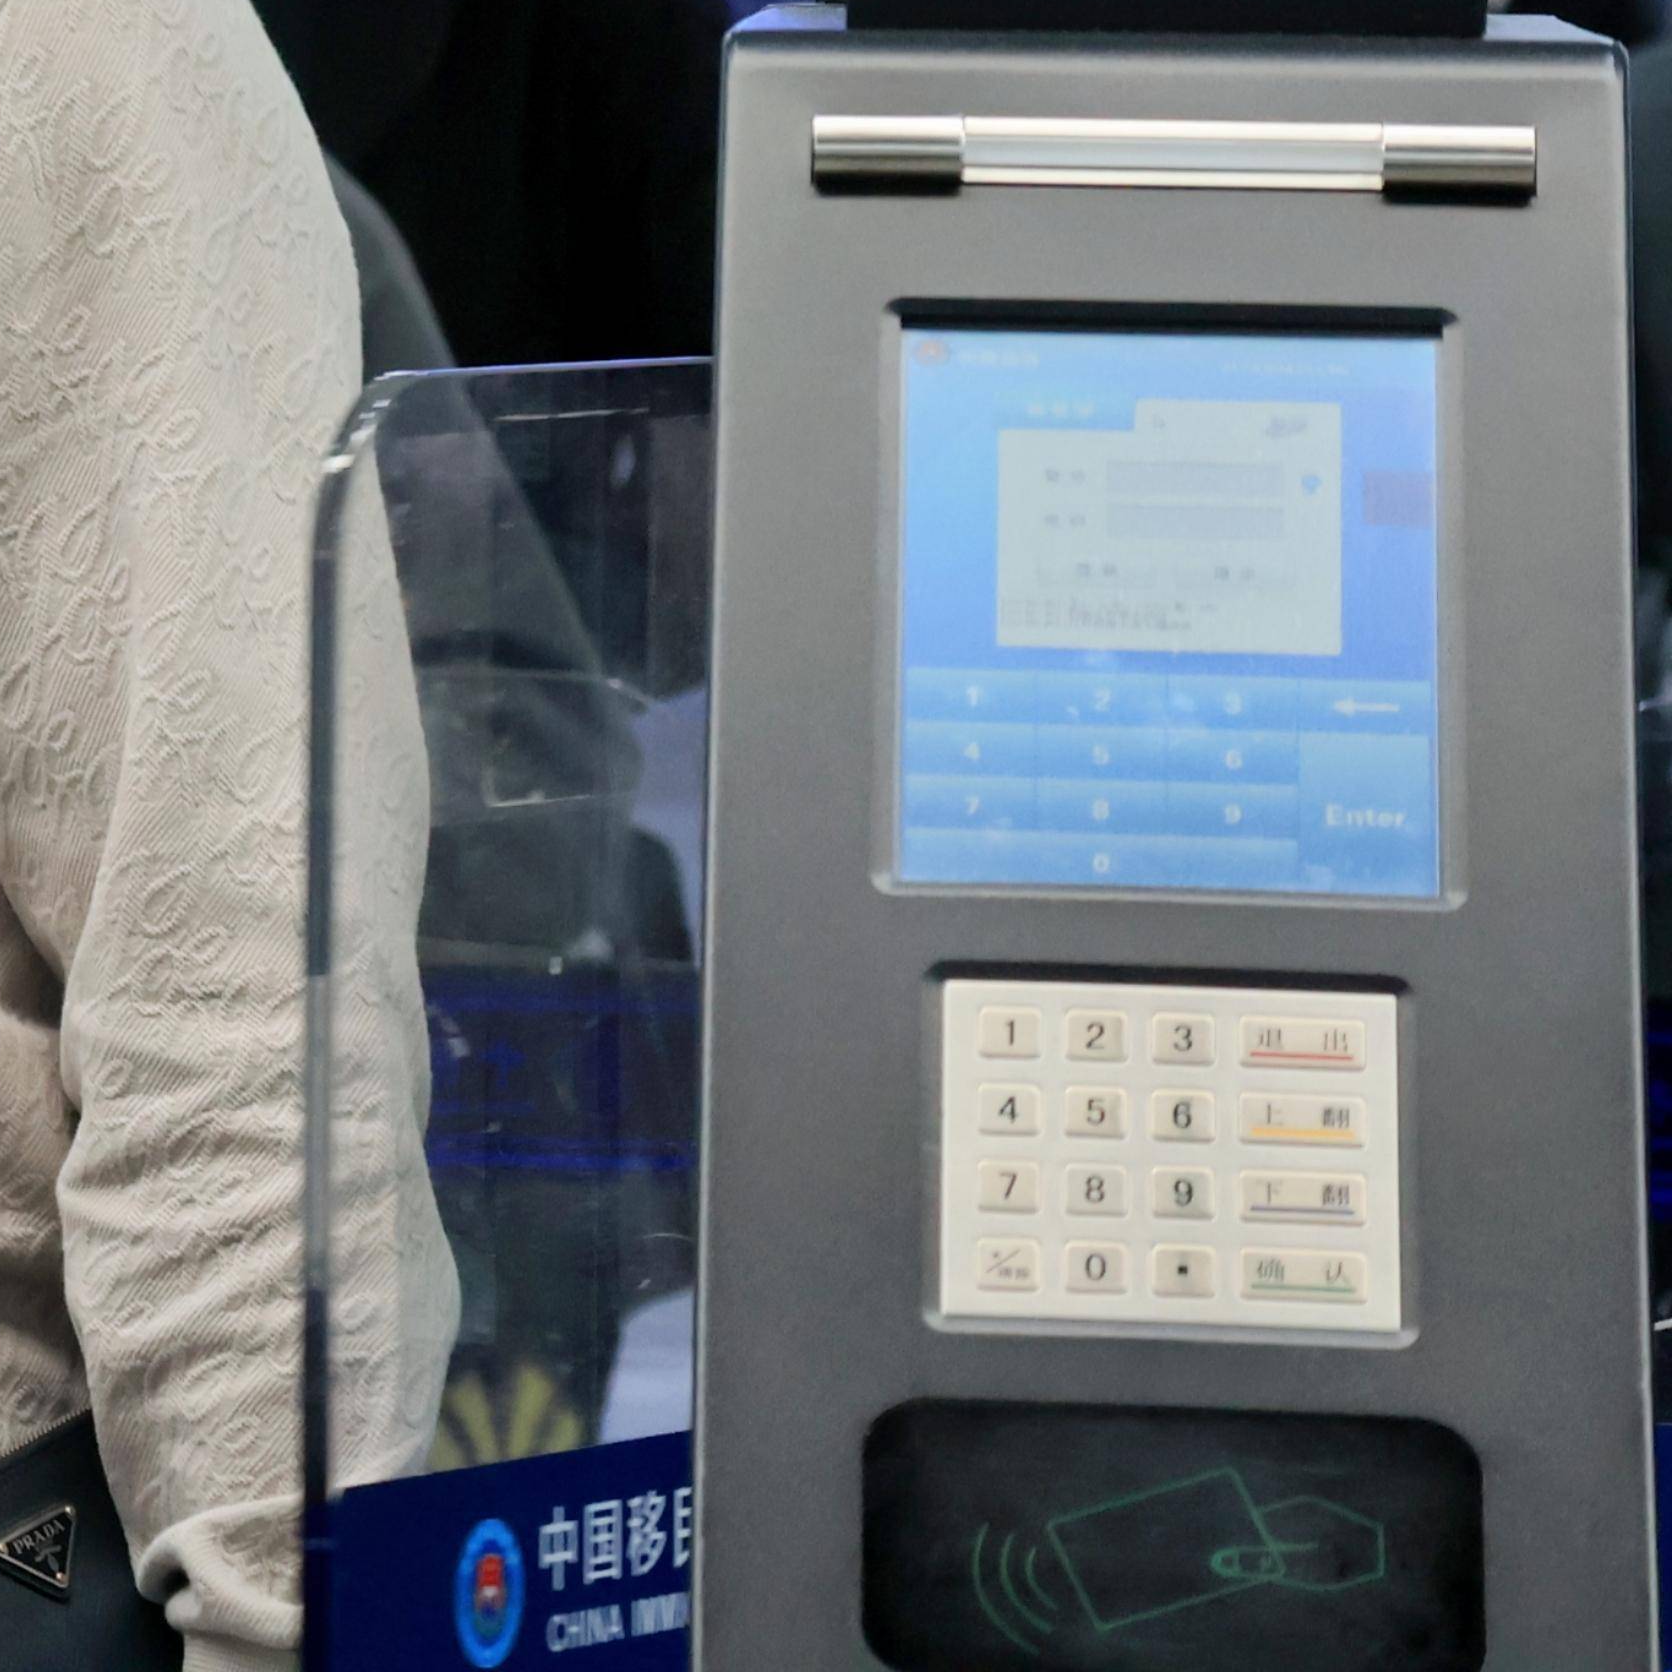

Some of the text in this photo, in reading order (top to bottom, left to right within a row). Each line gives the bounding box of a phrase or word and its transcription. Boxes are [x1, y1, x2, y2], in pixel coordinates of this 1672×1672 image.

[1324, 803, 1407, 829] Enter
[1004, 1018, 1193, 1052] 1 2 3
[998, 1095, 1193, 1129] 4 5 6
[999, 1171, 1194, 1207] 7 8 9
[1085, 1252, 1106, 1281] 0
[11, 1519, 65, 1555] PRADA
[545, 1604, 626, 1653] CHINA
